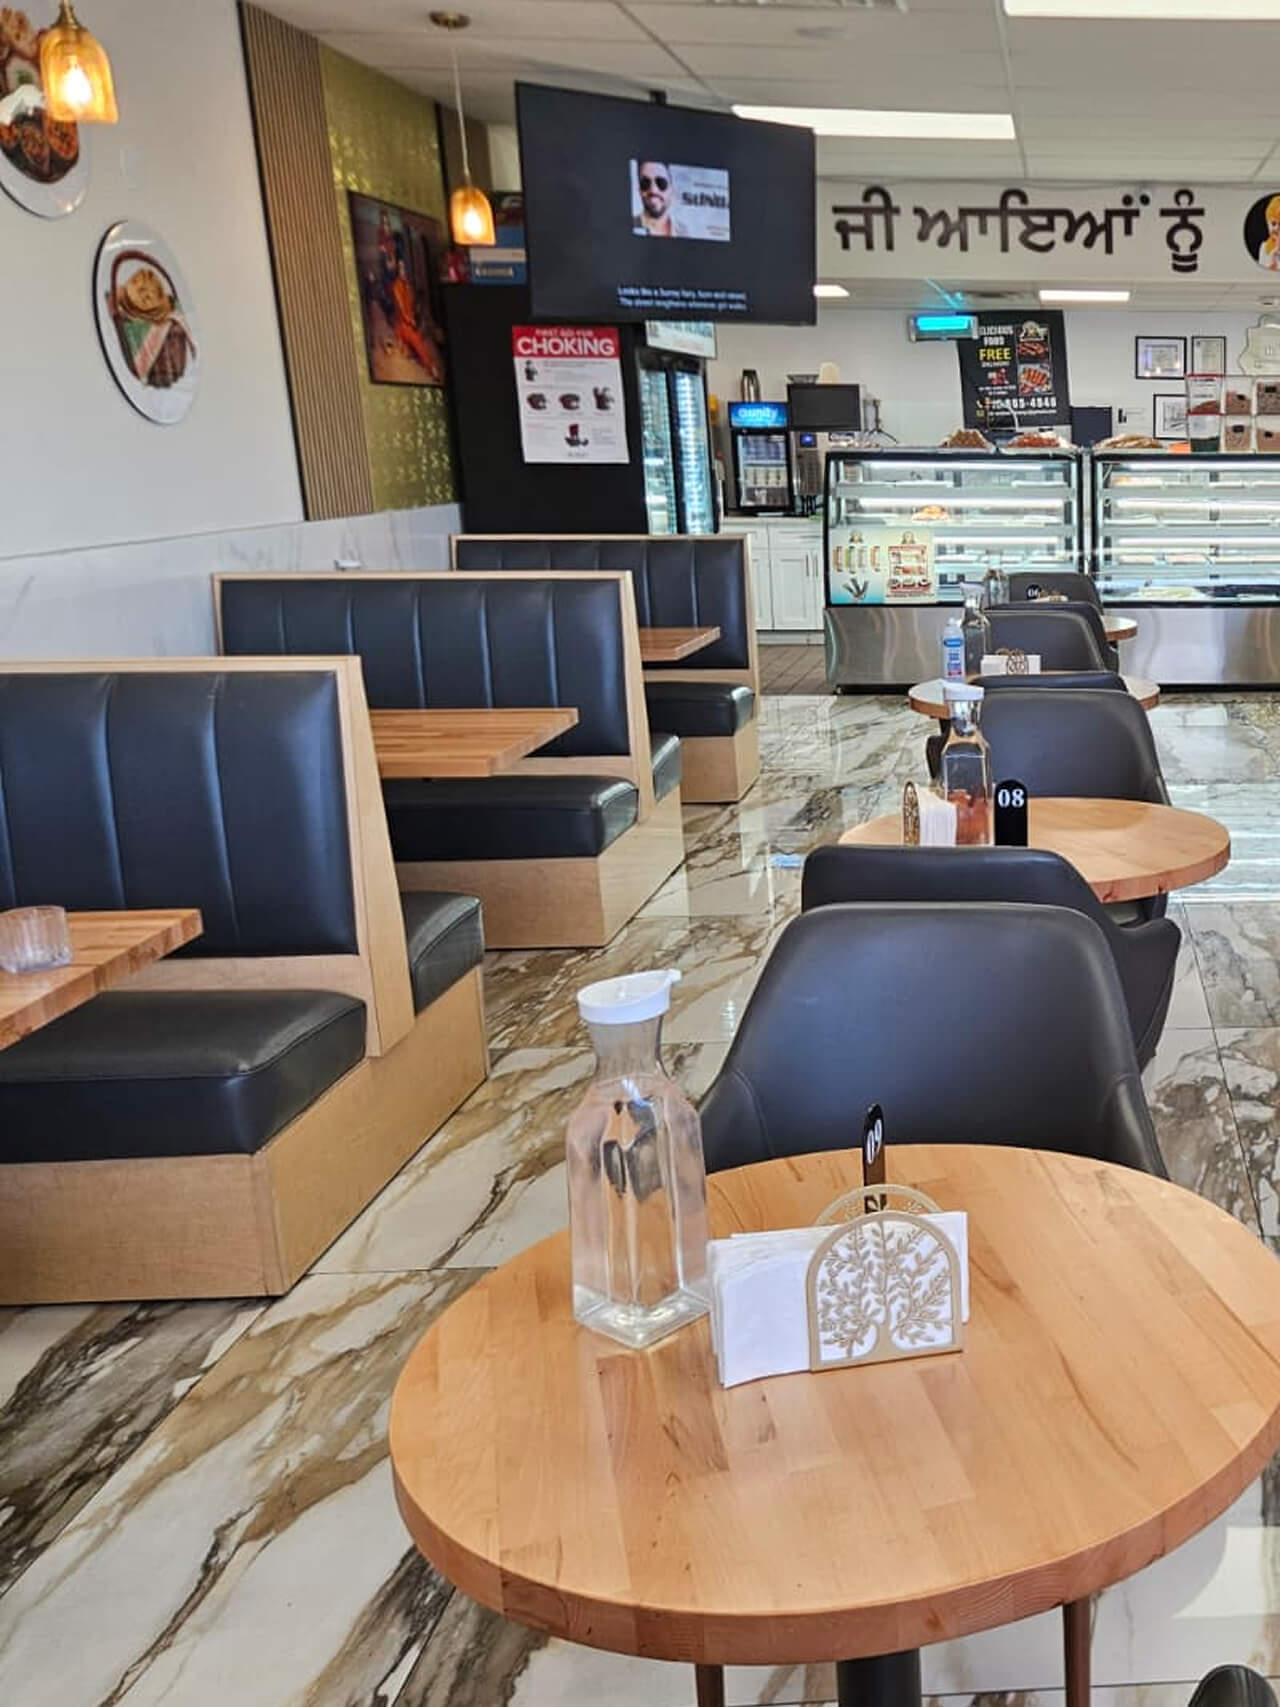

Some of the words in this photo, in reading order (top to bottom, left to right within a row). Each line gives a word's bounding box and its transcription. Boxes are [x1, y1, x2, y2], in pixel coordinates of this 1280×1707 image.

[831, 186, 901, 252] ਜੀ
[1159, 188, 1205, 273] ਨੂੰ
[516, 335, 616, 356] CHOKING
[979, 347, 1012, 361] FREE
[997, 788, 1025, 808] 08
